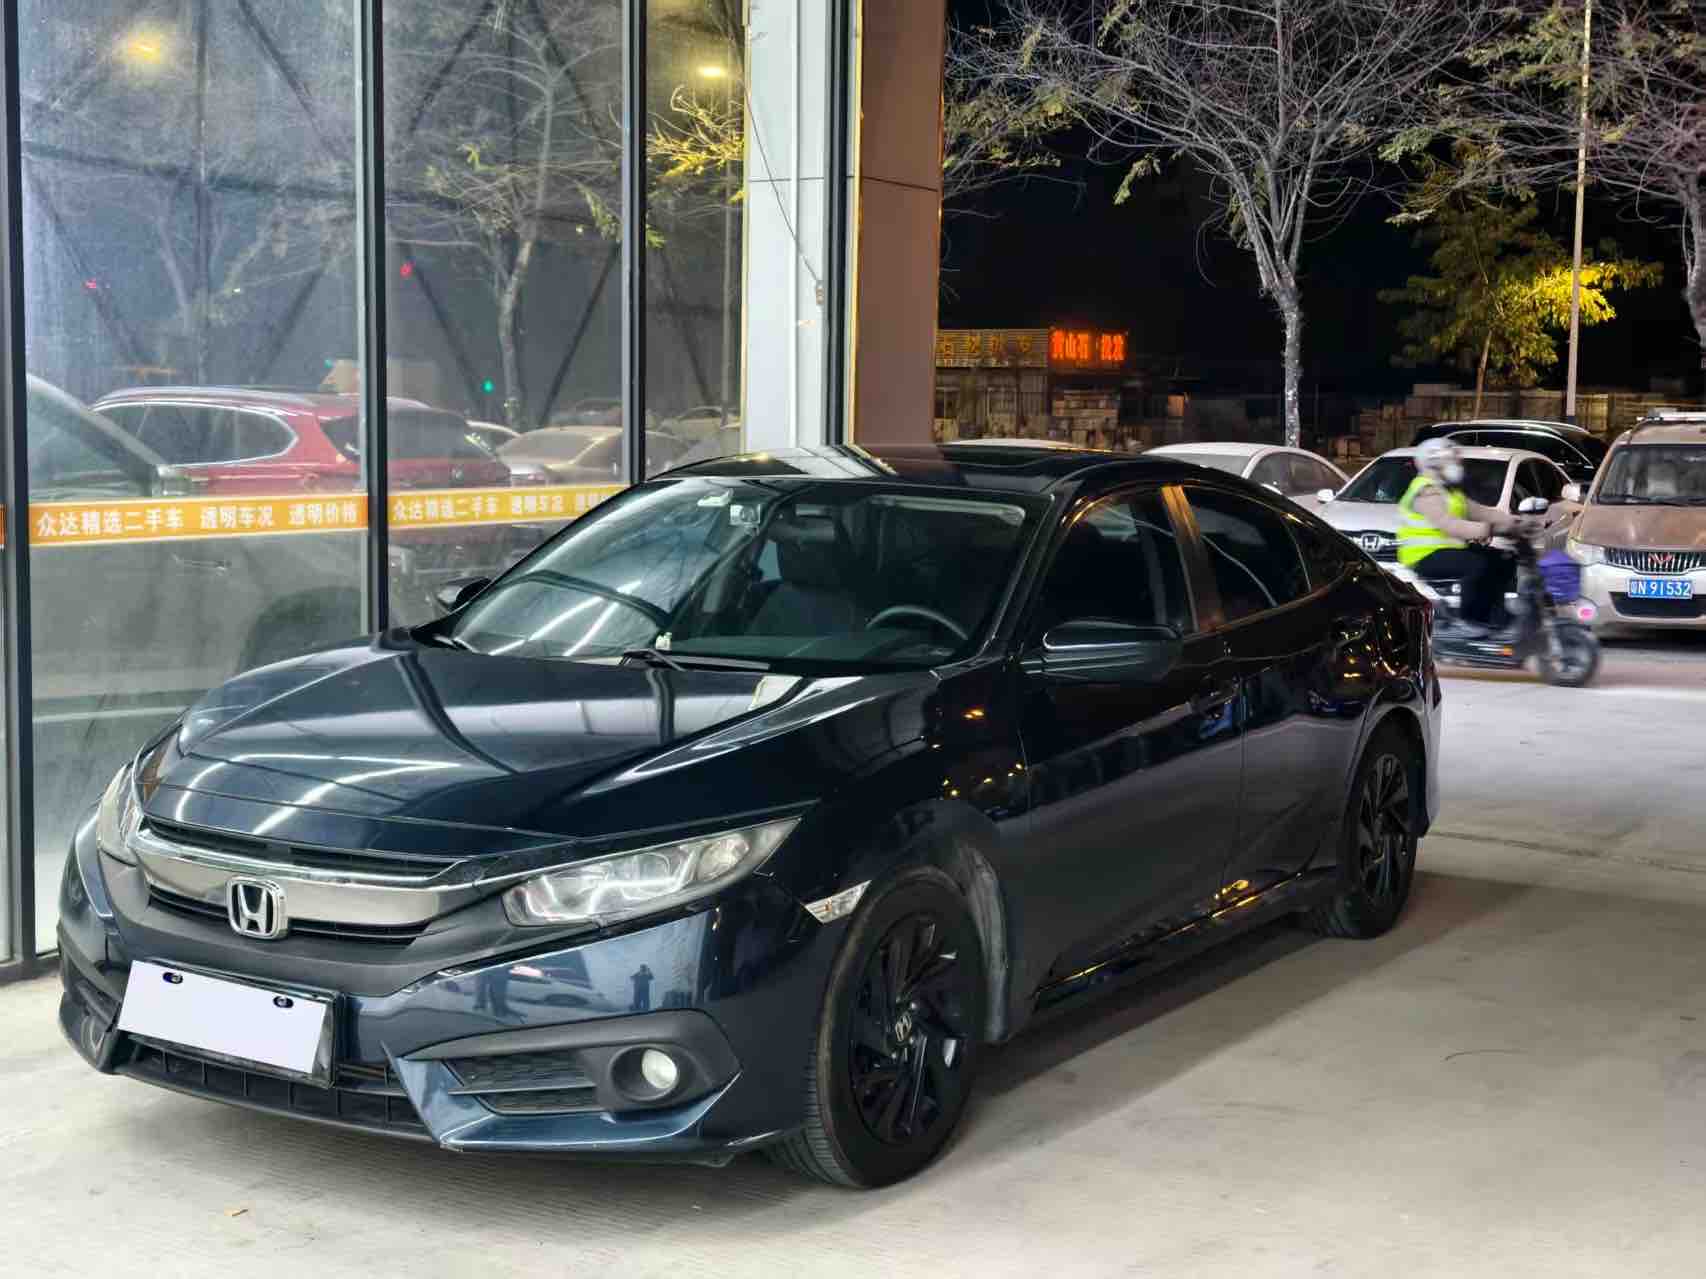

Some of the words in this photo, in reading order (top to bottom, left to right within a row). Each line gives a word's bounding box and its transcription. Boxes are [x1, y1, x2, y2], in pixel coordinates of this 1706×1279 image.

[37, 506, 184, 537] 众达精选二手车
[200, 504, 276, 529] 透明车况
[288, 501, 357, 526] 透明价格
